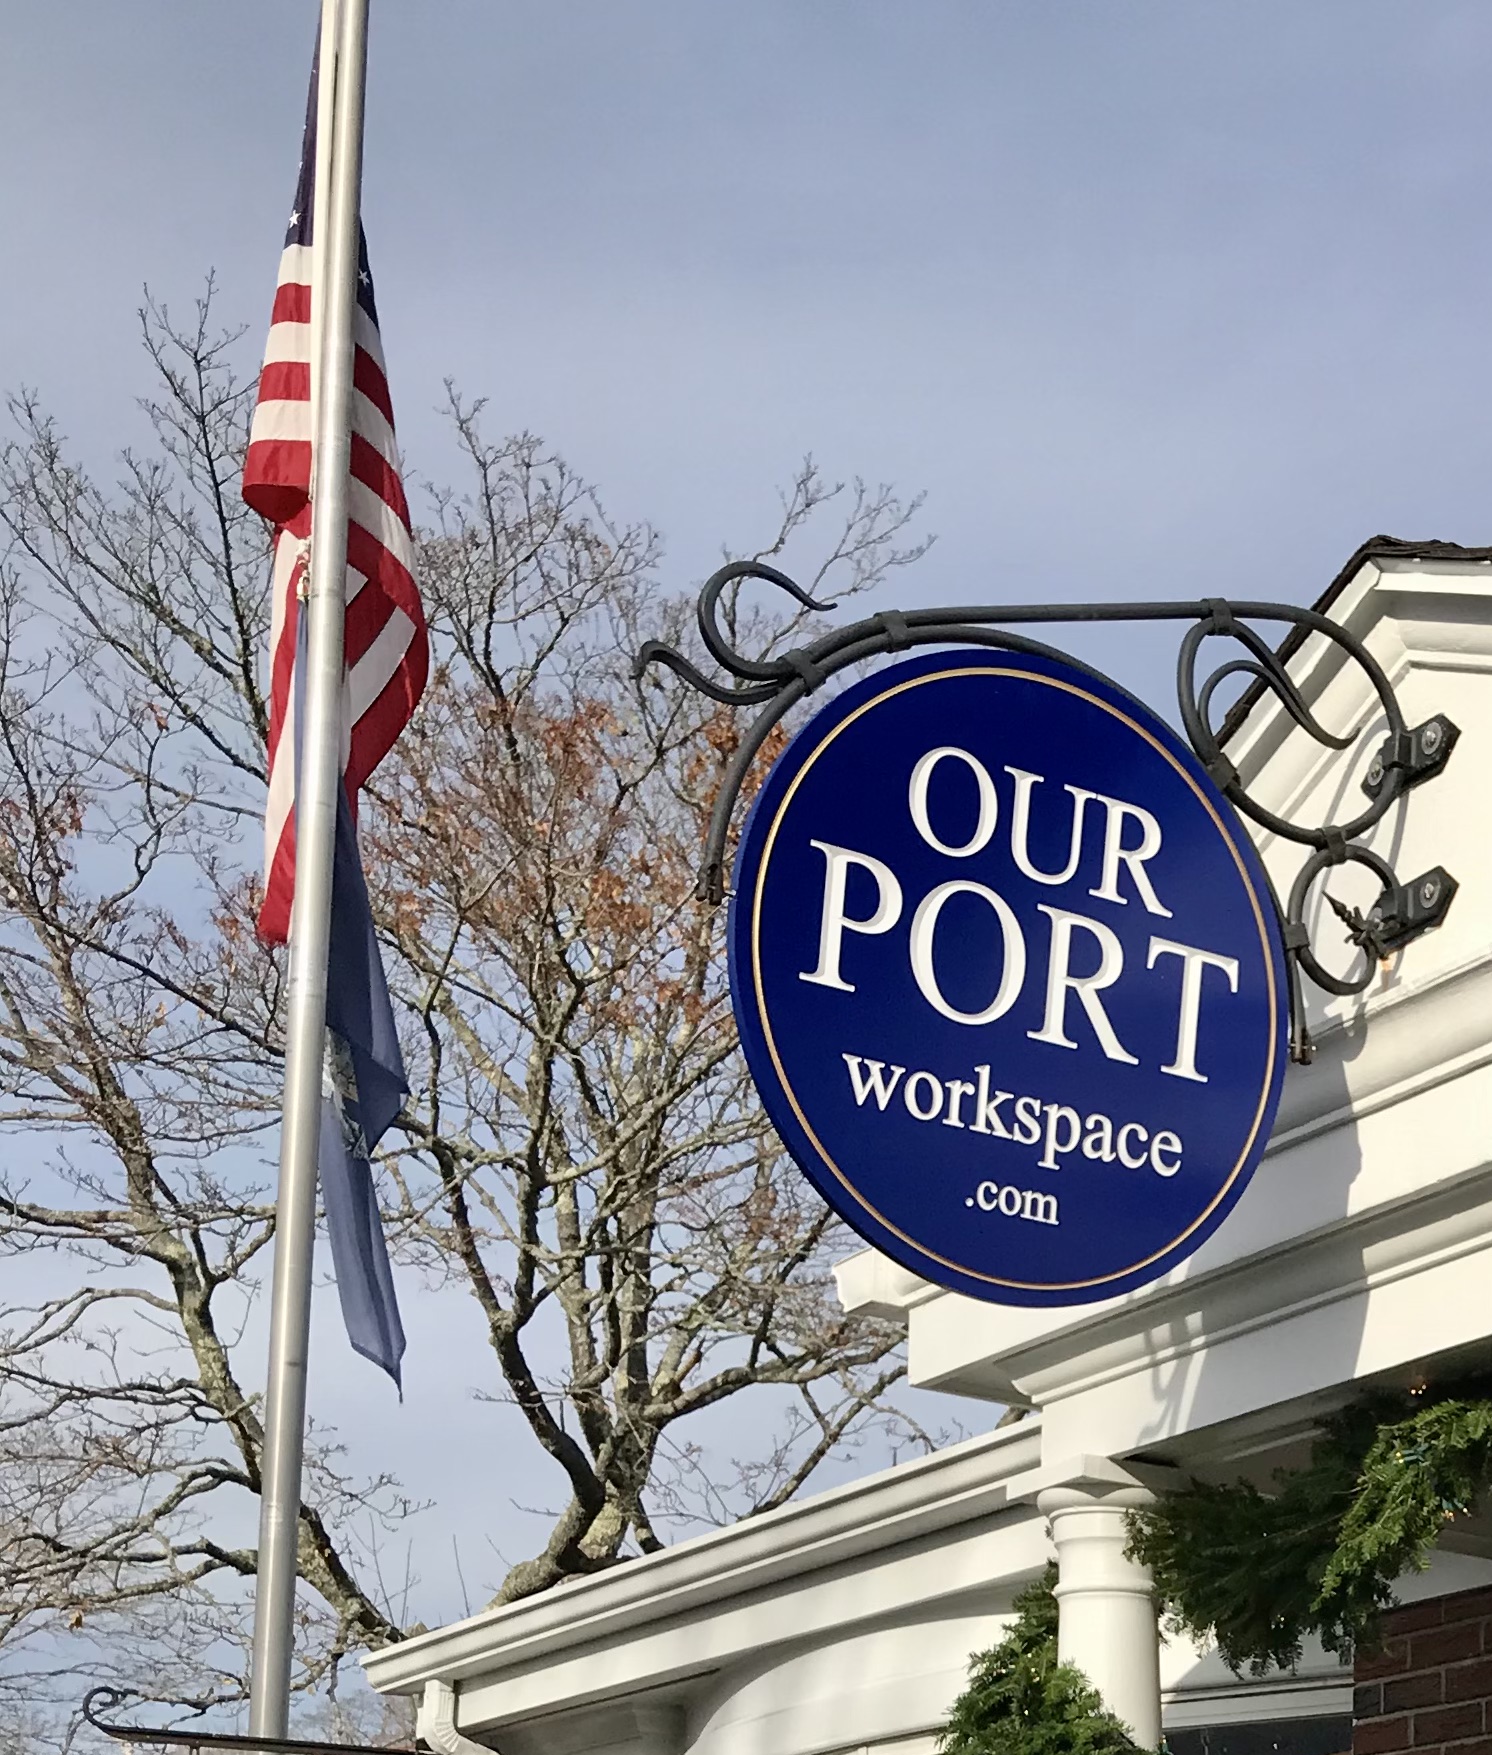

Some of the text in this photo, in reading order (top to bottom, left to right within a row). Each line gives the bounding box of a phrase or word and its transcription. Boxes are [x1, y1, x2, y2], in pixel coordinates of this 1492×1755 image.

[908, 746, 1173, 918] OUR
[799, 839, 1239, 1083] PORT
[841, 1052, 1183, 1178] workspace
[964, 1181, 1060, 1226] .com
